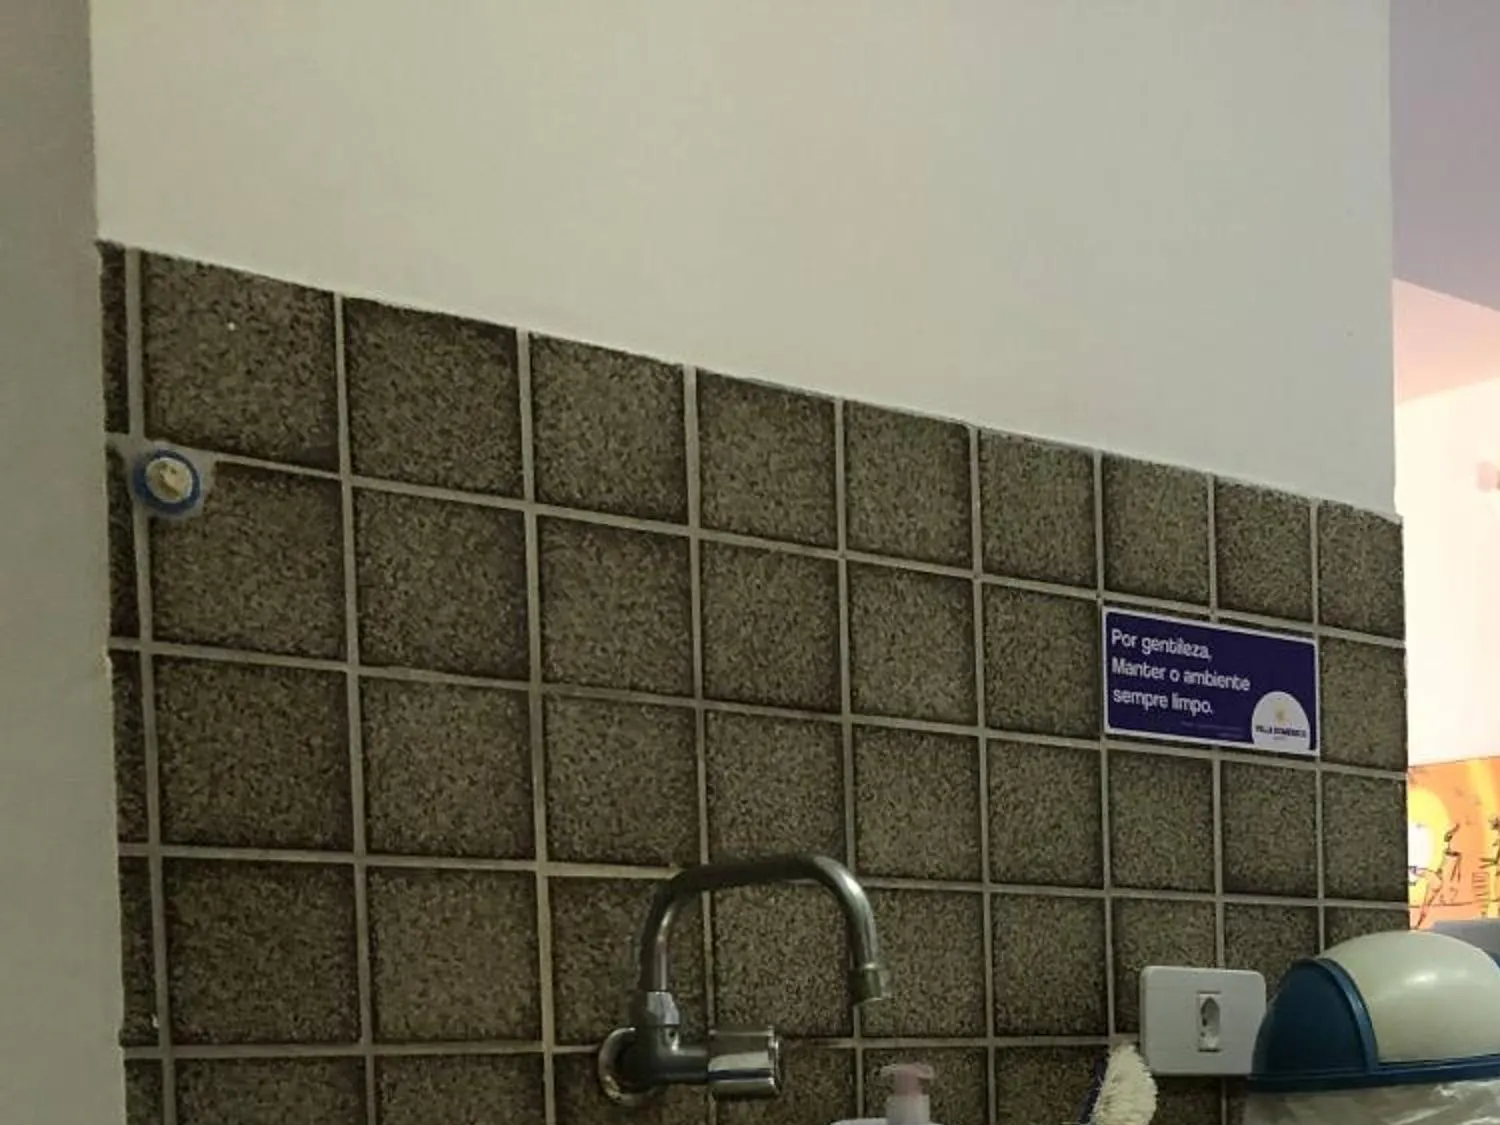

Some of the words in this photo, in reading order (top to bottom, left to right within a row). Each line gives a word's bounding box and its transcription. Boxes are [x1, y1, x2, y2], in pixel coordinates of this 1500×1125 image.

[1111, 628, 1137, 648] Por
[1111, 656, 1165, 680] Manter
[1169, 669, 1180, 683] o
[1183, 670, 1251, 691] ambiente
[1113, 688, 1168, 711] sempre
[1171, 692, 1213, 716] limpo.
